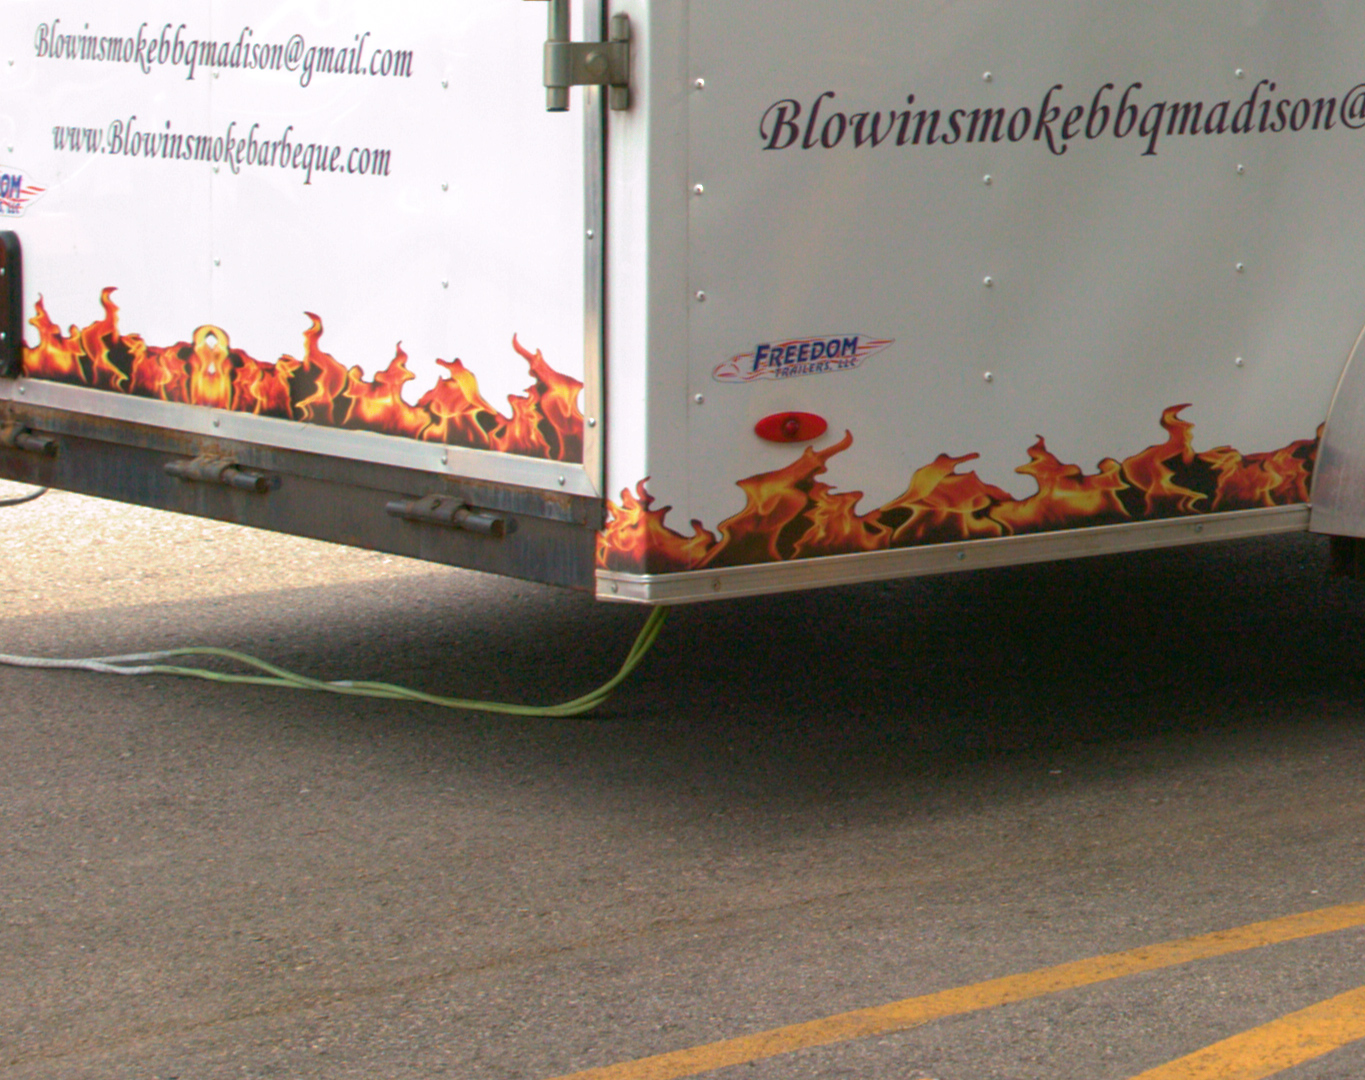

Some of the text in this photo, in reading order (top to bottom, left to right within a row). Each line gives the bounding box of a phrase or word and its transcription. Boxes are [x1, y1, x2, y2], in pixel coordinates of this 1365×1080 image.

[34, 19, 414, 87] Blowinsmokebbqmadison@gmail.com
[52, 116, 391, 185] www.Blowinsmokebarbeque.com
[752, 337, 859, 372] FREEDOM
[838, 356, 858, 369] LLC
